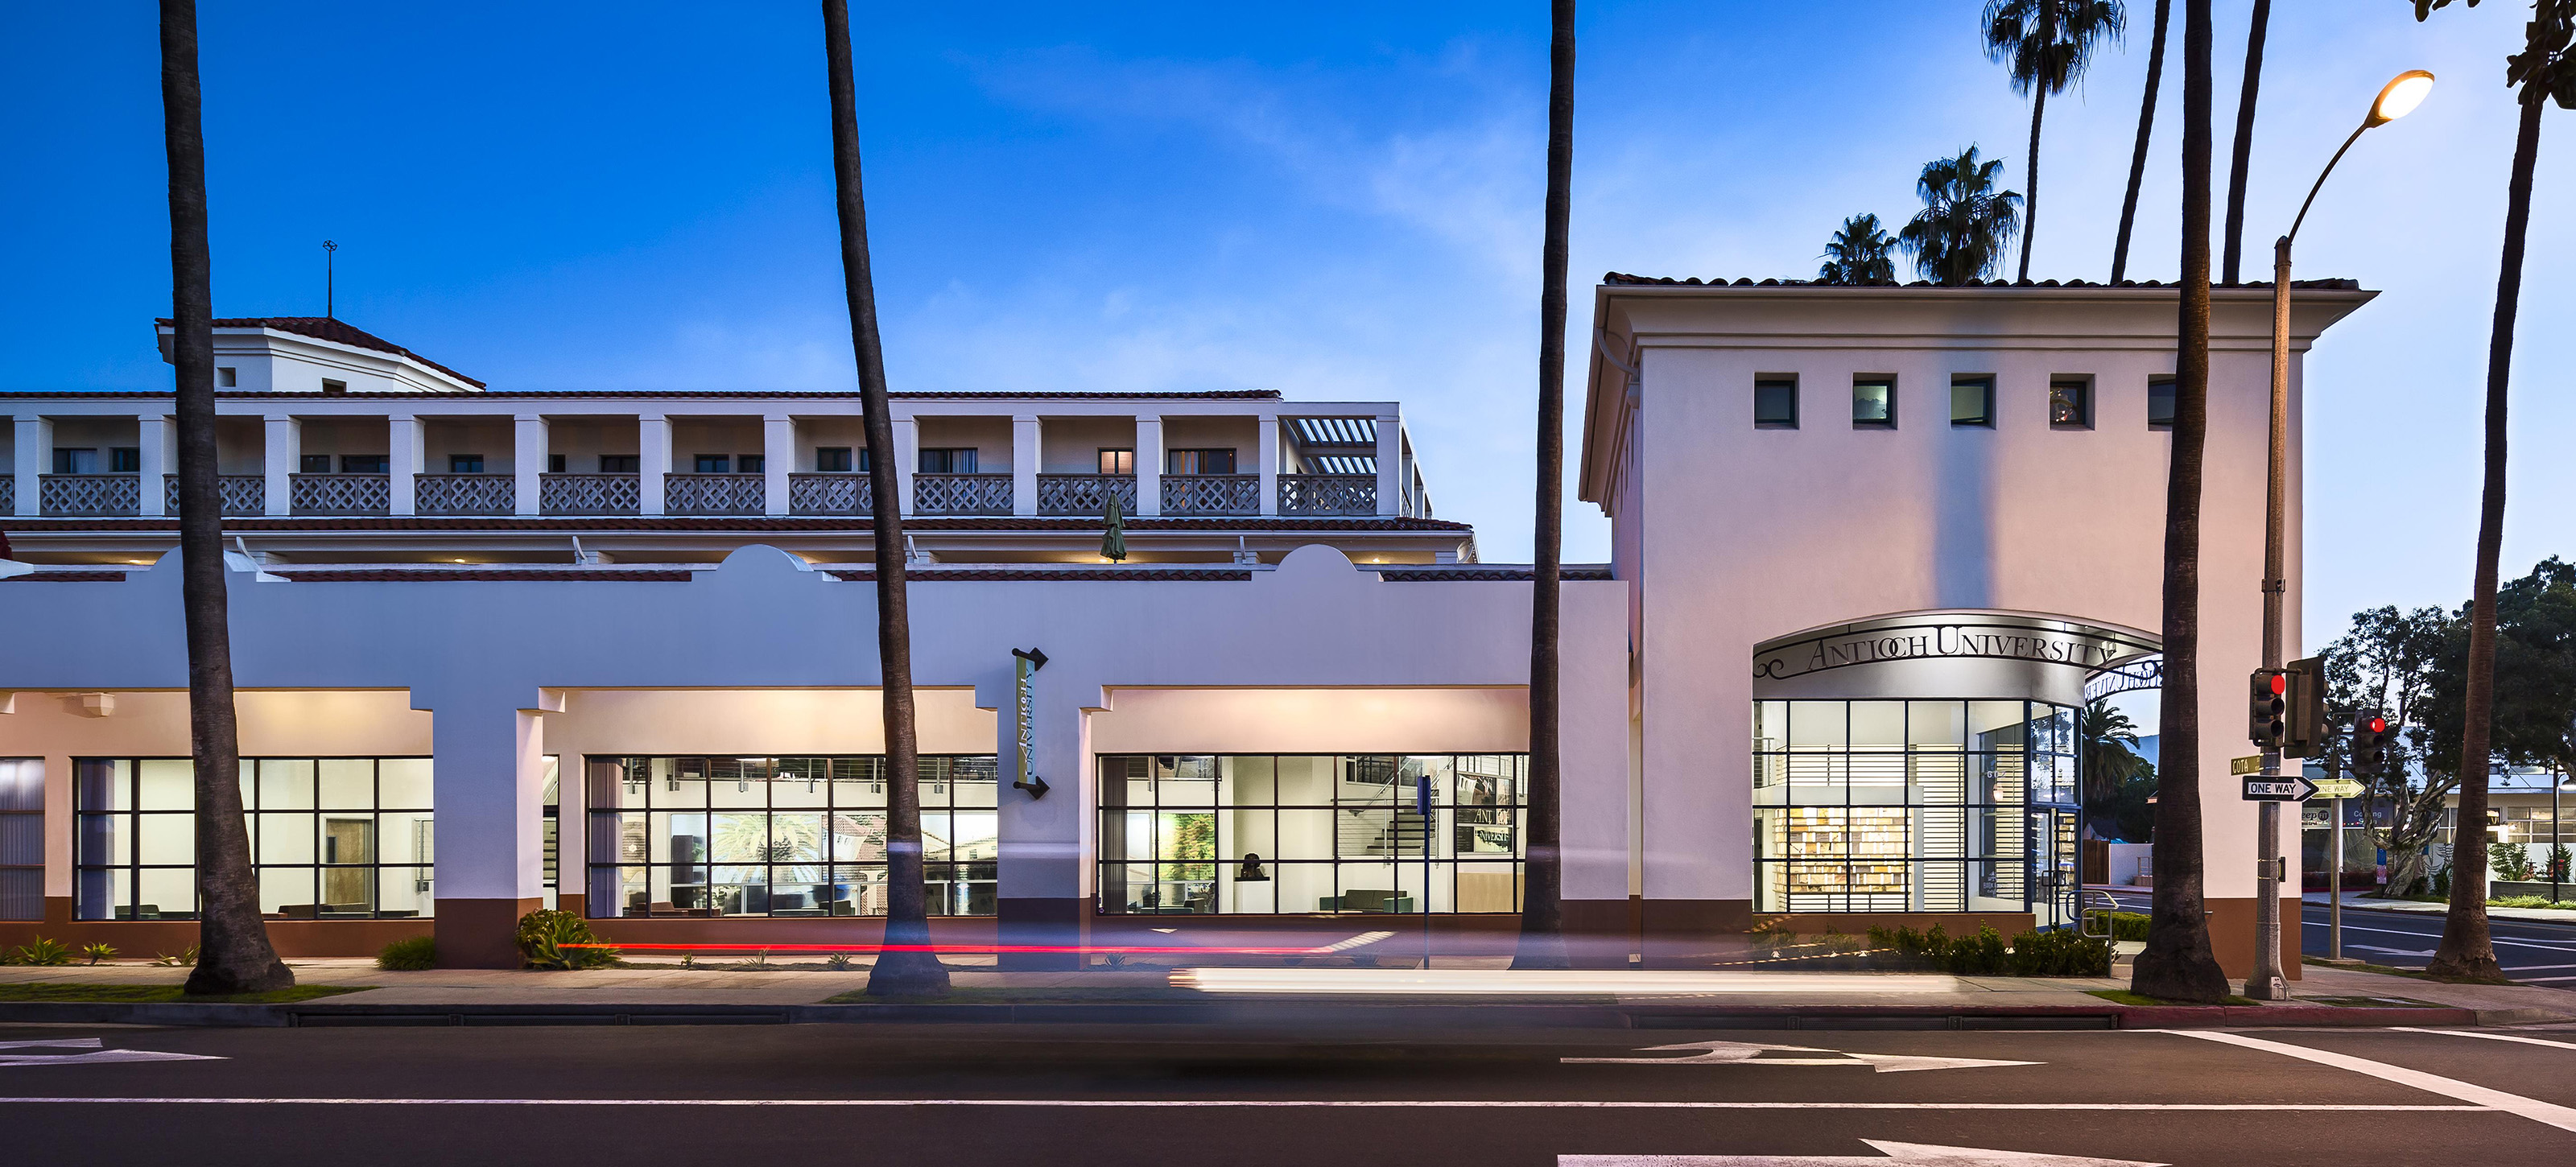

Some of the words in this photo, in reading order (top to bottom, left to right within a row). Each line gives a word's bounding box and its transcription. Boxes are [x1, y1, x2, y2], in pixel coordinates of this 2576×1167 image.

[1806, 635, 1930, 670] ANTIOCH
[1933, 625, 2117, 667] UNIVERSITY
[1025, 668, 1034, 777] UNIVERSITY
[2232, 759, 2248, 773] COTA
[2251, 784, 2271, 794] ONE
[2275, 784, 2296, 794] WAY
[2354, 810, 2382, 819] Cong
